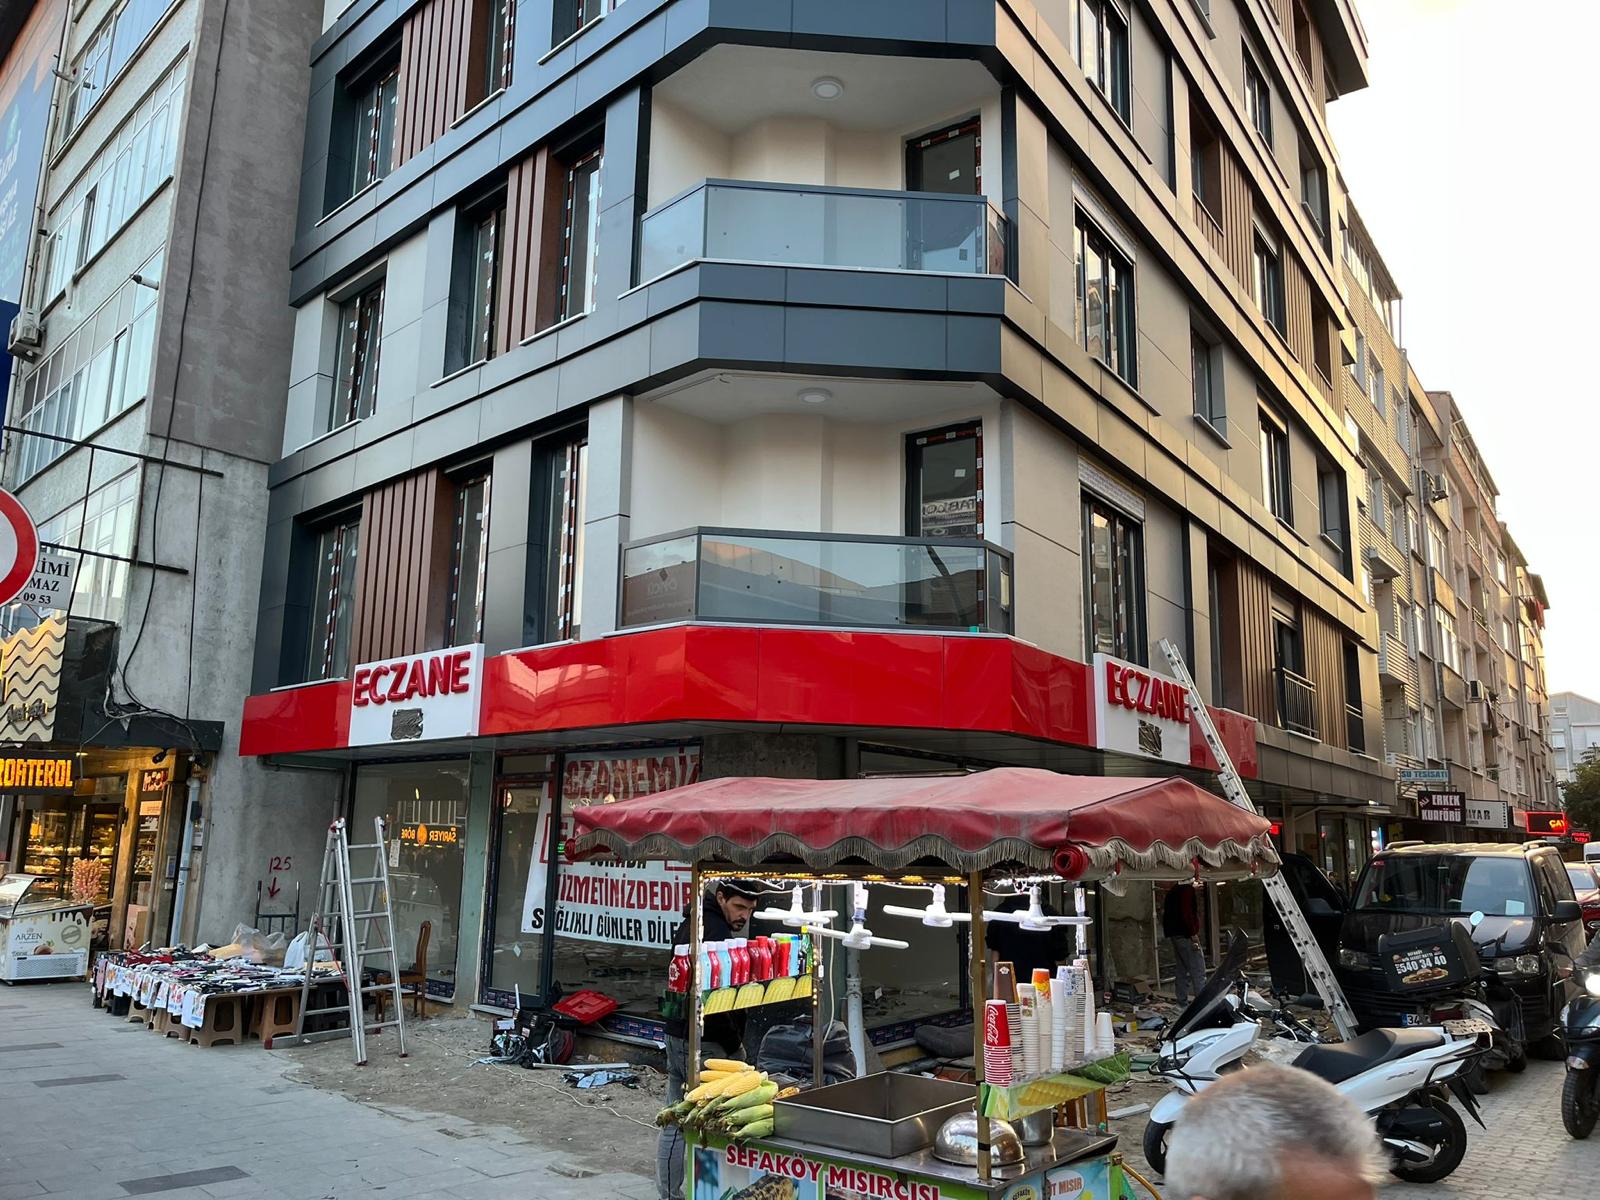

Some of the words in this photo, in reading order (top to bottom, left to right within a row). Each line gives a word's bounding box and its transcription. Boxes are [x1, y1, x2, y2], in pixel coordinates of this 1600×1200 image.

[36, 558, 70, 577] İMİ
[30, 577, 60, 592] MAZ
[23, 592, 36, 602] 09
[38, 595, 51, 605] 53
[353, 650, 471, 707] ECZANE
[1106, 661, 1190, 724] ECZANE
[1431, 794, 1460, 806] ERKEK
[1421, 808, 1461, 822] KUAFÖRÜ
[269, 856, 291, 874] 125
[531, 906, 593, 936] SĞLIKLI
[596, 911, 643, 942] GÜNLER
[647, 915, 679, 945] DİLE
[15, 932, 43, 941] ARZEN
[1400, 960, 1419, 974] 540
[1419, 957, 1433, 969] 34
[1434, 955, 1448, 966] 40
[725, 1144, 822, 1183] SEFAKÖY
